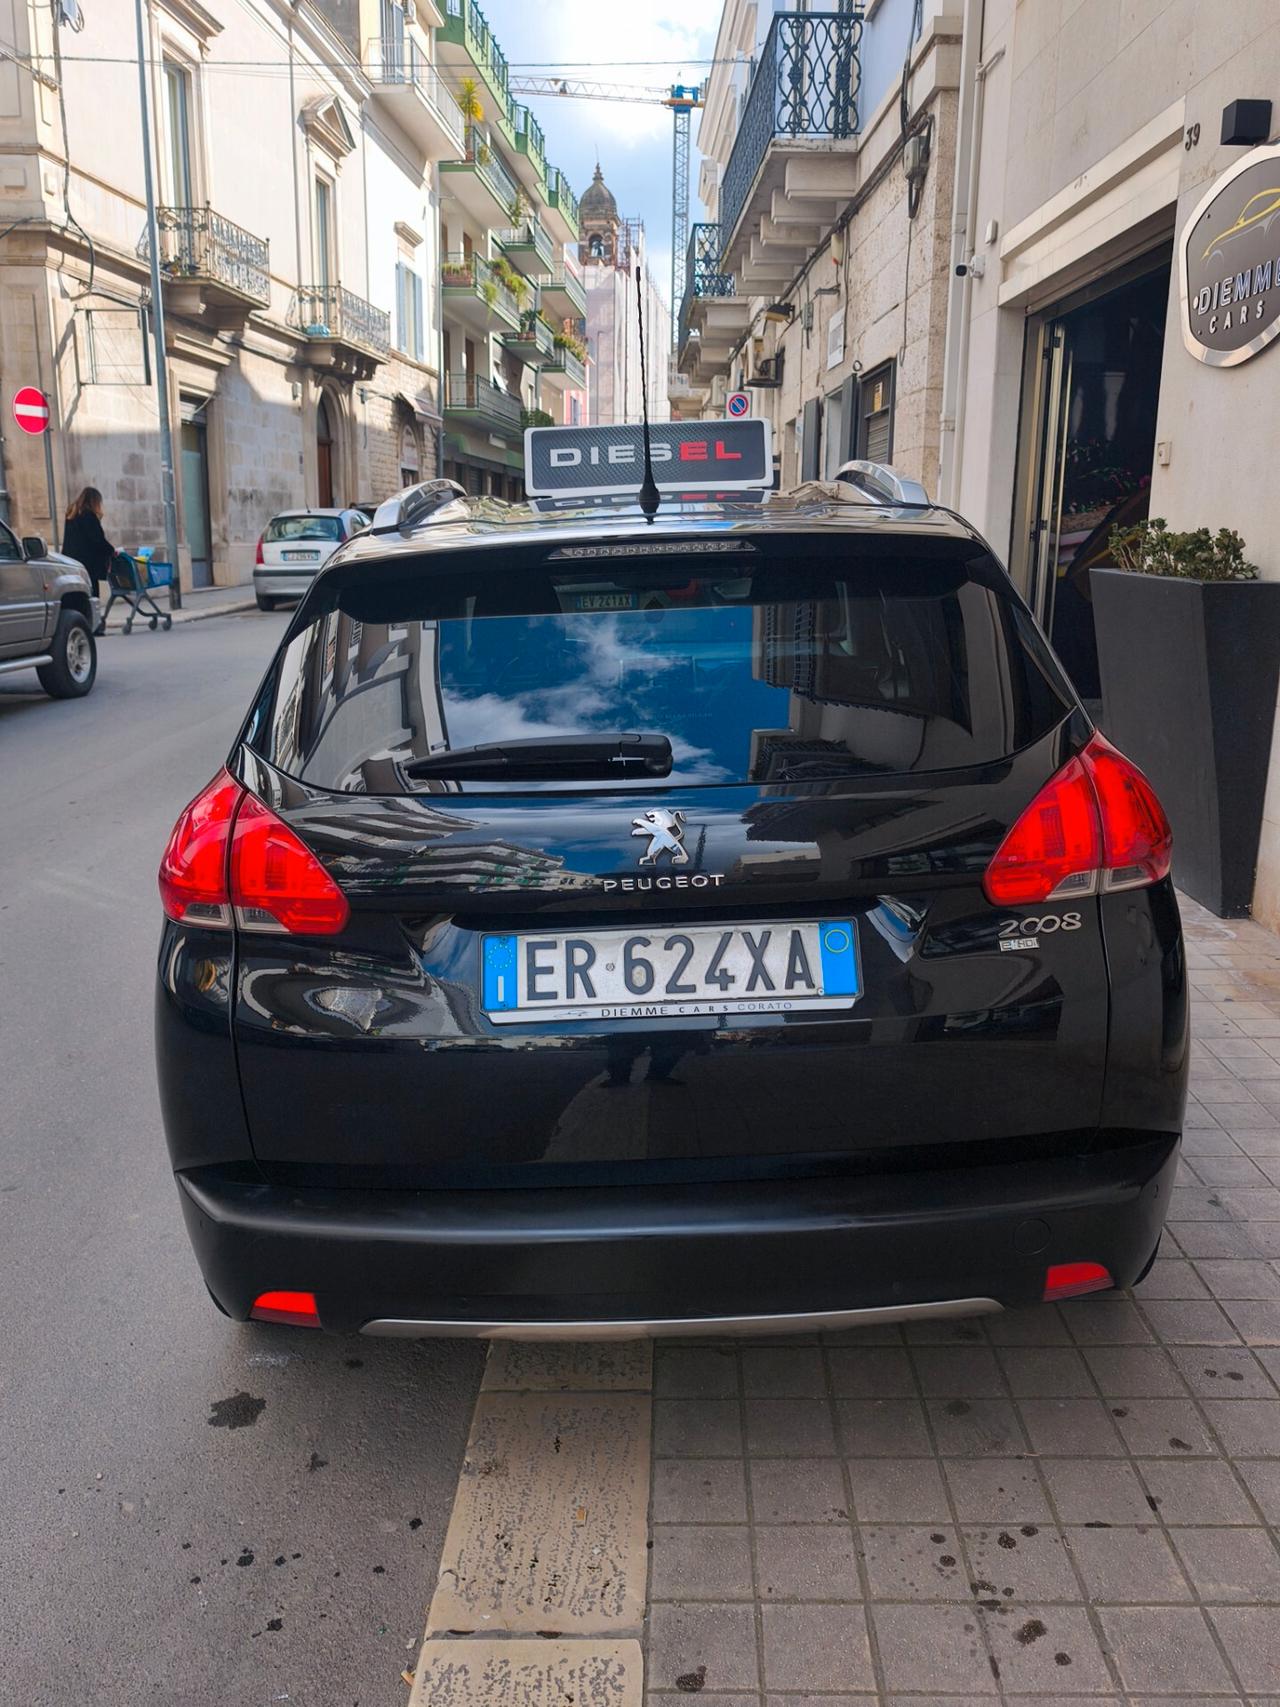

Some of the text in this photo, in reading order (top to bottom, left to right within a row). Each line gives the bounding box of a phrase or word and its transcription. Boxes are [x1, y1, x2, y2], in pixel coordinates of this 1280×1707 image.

[1185, 122, 1201, 152] 39
[1209, 299, 1264, 334] CARS
[549, 440, 742, 467] DIESEL
[603, 873, 725, 892] PEUGEOT
[998, 912, 1082, 938] 2008
[526, 929, 816, 1001] ER 624XA
[601, 1002, 793, 1018] DIEMME CARS CORATO
